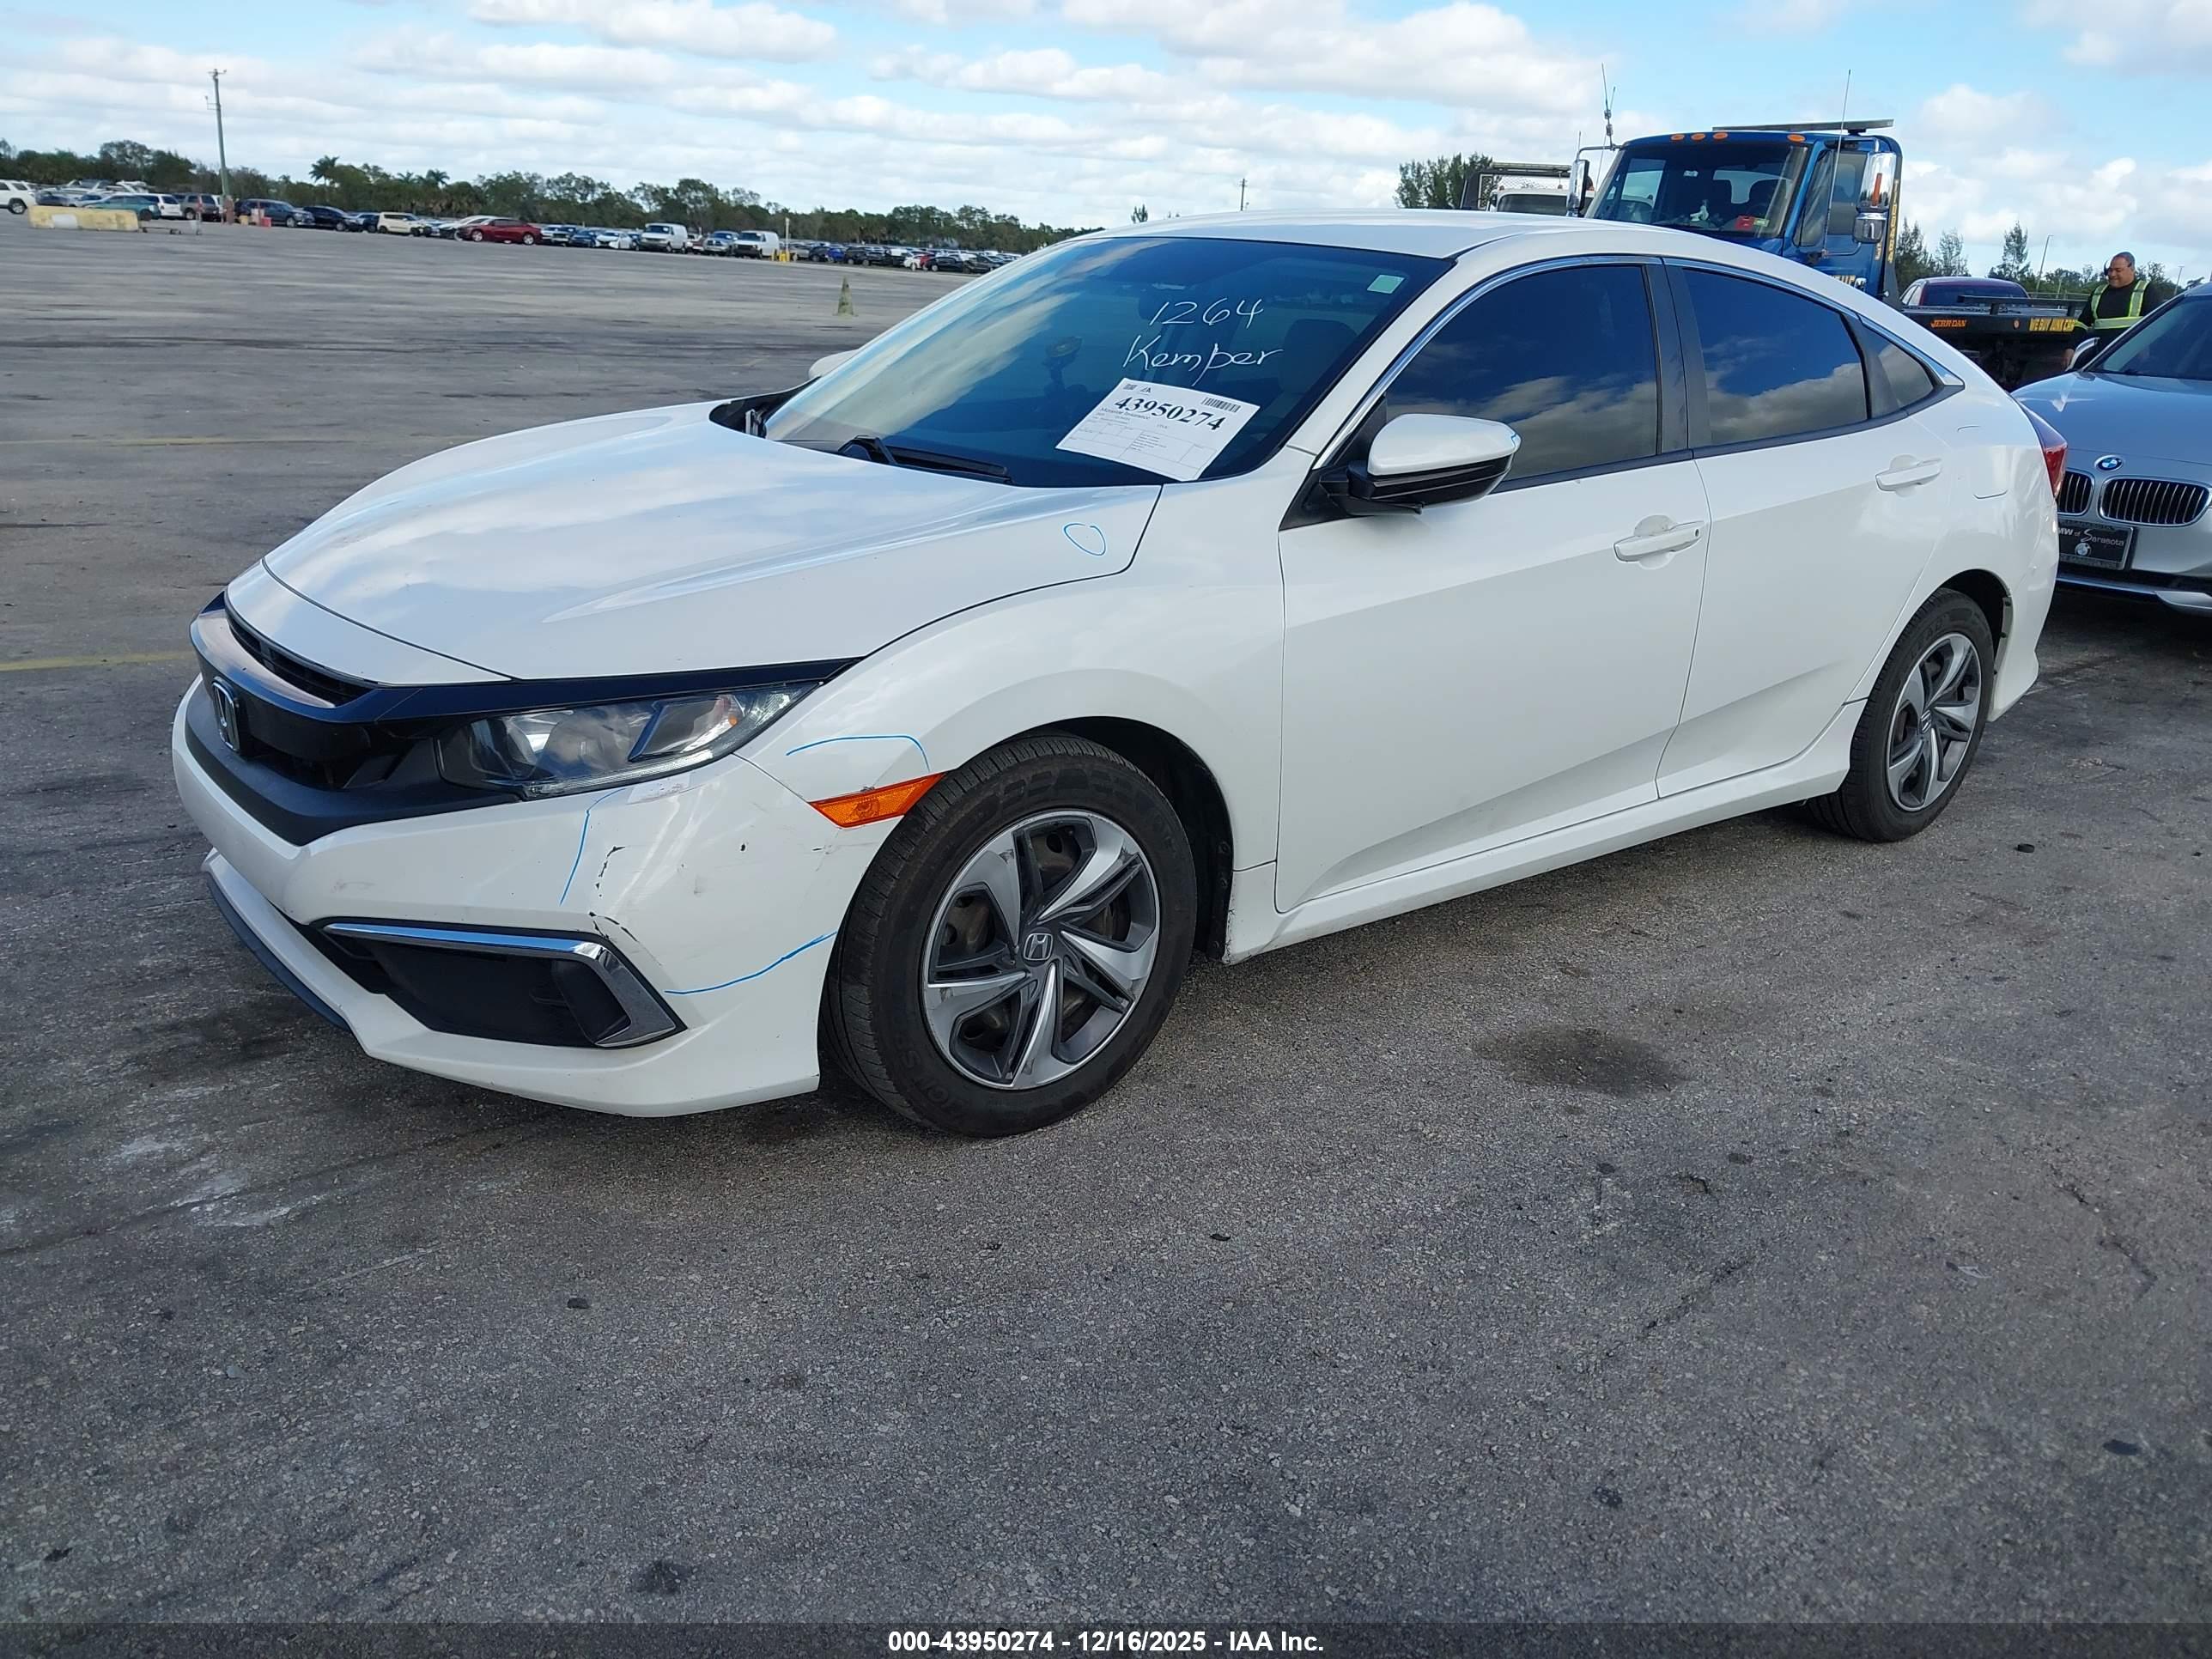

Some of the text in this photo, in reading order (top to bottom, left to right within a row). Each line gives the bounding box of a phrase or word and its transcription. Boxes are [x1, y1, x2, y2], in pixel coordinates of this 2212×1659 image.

[1149, 297, 1265, 329] 1264
[1122, 335, 1284, 386] Kemper
[1115, 397, 1226, 430] 43950274
[2081, 529, 2124, 546] Sarasota
